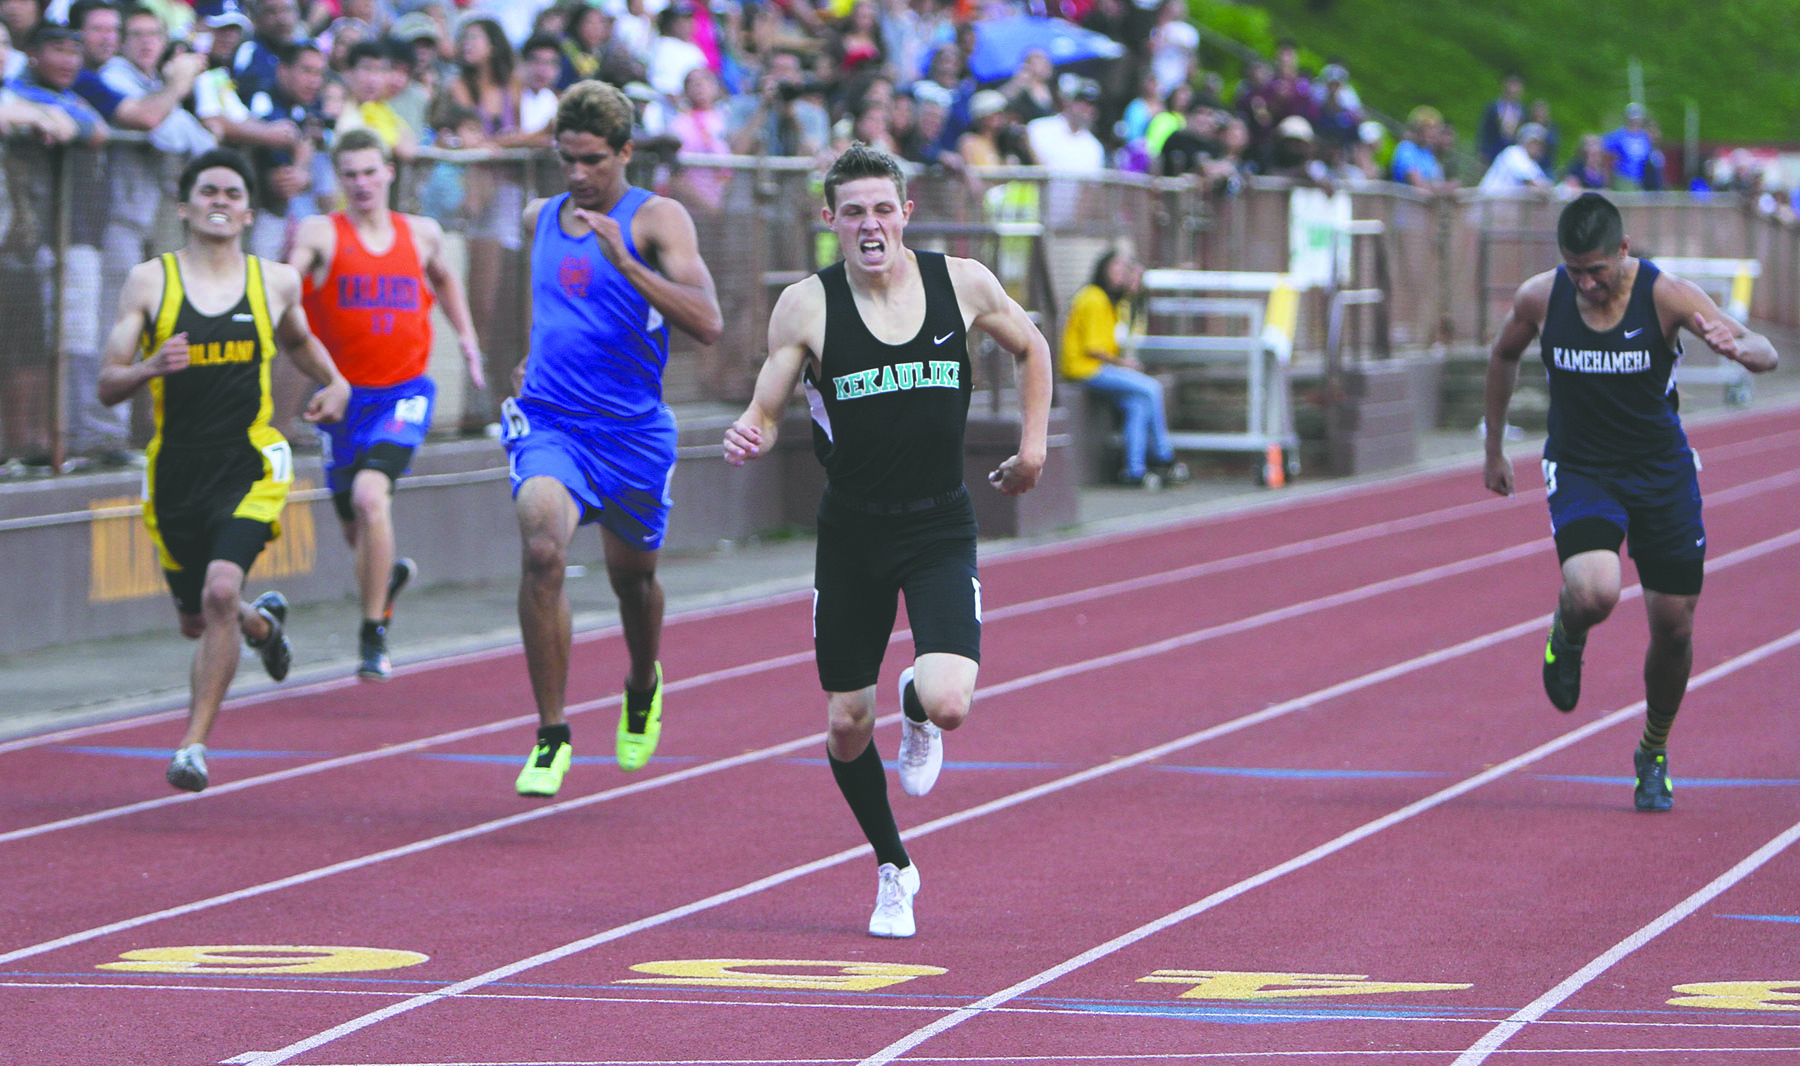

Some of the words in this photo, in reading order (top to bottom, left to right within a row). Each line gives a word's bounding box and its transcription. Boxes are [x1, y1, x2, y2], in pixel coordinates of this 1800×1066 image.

[1553, 347, 1651, 374] KAMEHAMEHA
[269, 446, 287, 480] 7
[613, 958, 947, 991] 5
[1136, 969, 1474, 999] 4
